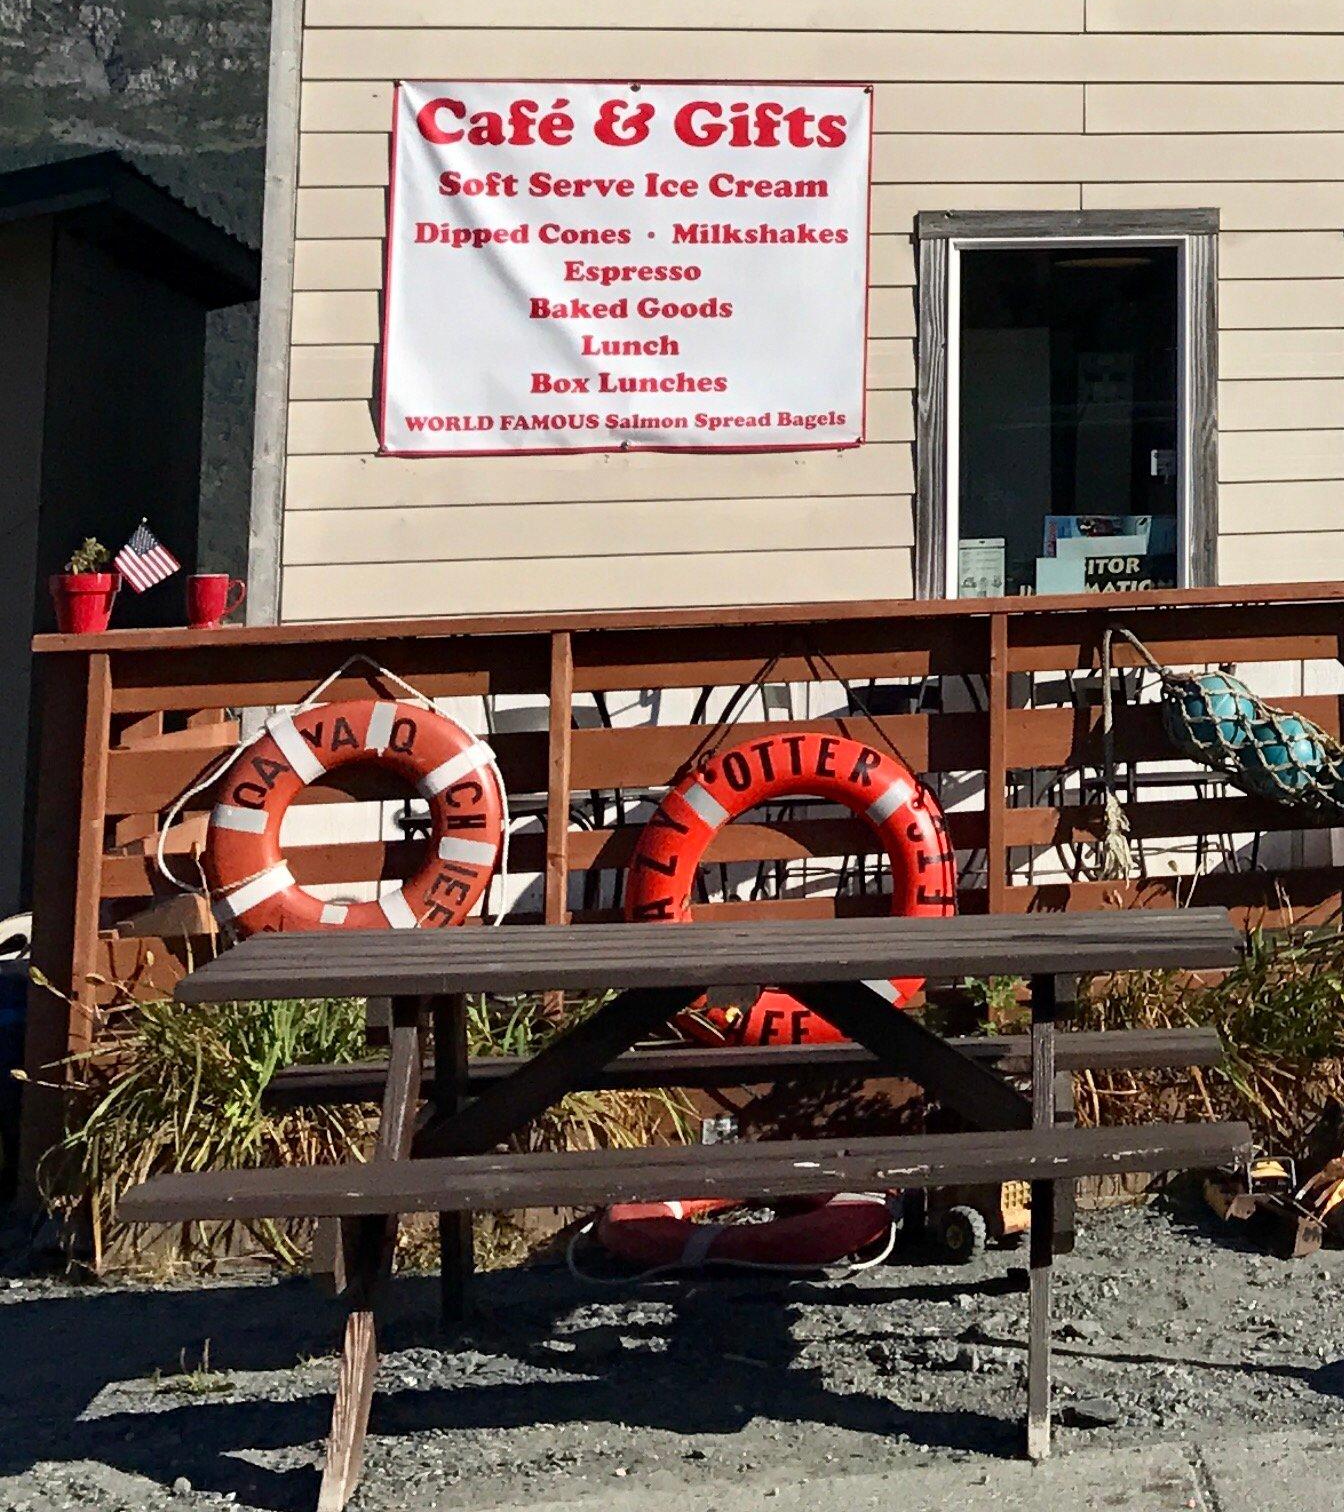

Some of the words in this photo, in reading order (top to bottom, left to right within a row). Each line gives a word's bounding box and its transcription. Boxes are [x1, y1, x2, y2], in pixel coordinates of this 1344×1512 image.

[416, 97, 574, 146] Café
[594, 99, 655, 147] &
[675, 101, 847, 148] Gifts
[439, 170, 518, 199] Soft
[528, 173, 634, 198] Serve
[645, 173, 698, 198] Ice
[709, 173, 829, 198] Cream
[414, 221, 529, 249] Dipped
[538, 224, 631, 245] Cones
[671, 223, 849, 245] Milkshakes
[564, 261, 701, 286] Espresso
[529, 298, 628, 319] Baked
[637, 298, 733, 319] Goods
[581, 334, 680, 356] Lunch
[530, 373, 590, 394] Box
[598, 373, 728, 394] Lunches
[405, 415, 494, 432] WORLD
[500, 414, 599, 431] FAMOUS
[605, 413, 688, 430] Salmon
[694, 412, 772, 431] Spread
[777, 411, 846, 430] Bagels
[1084, 557, 1140, 574] ITOR
[721, 735, 882, 792] OTTER
[633, 804, 689, 921] AZY
